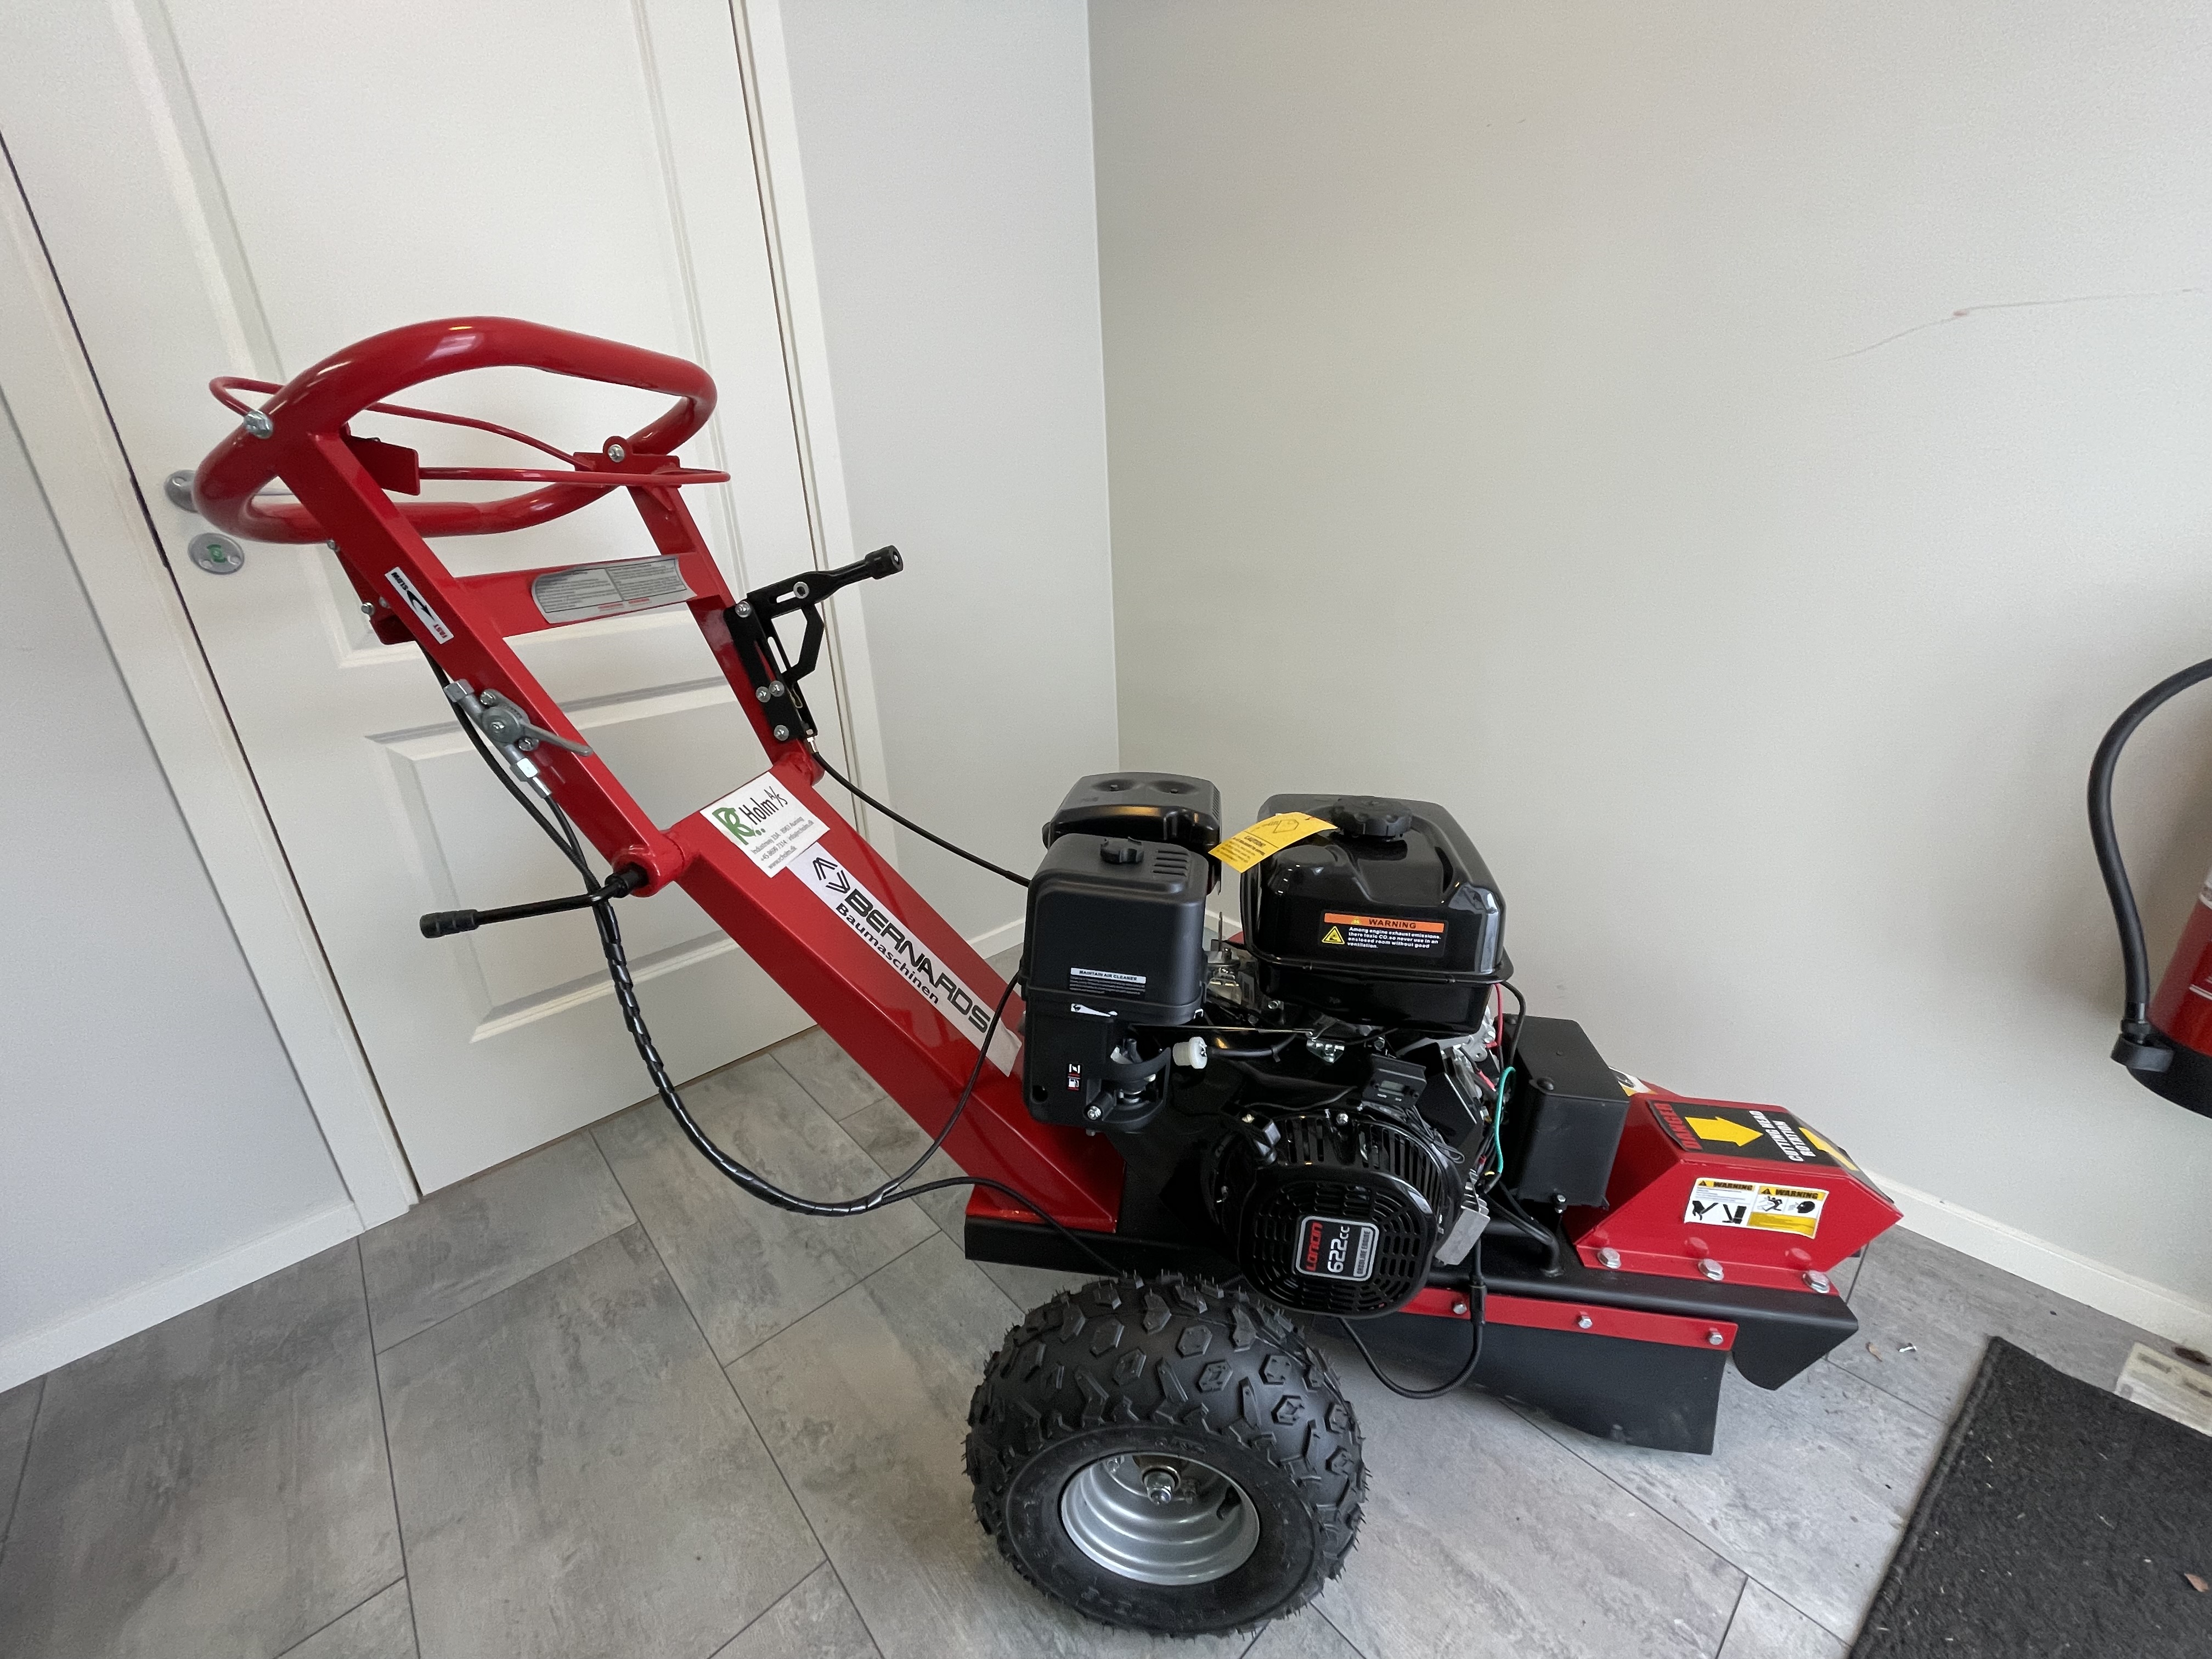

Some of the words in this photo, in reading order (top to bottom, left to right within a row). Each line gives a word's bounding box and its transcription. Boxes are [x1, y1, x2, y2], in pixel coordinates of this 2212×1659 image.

[391, 572, 408, 591] SLOW
[433, 624, 448, 639] FAST
[738, 797, 779, 825] Holm
[1369, 919, 1417, 929] WARNING
[836, 903, 939, 1004] Baumaschinen
[844, 888, 991, 1034] BERNARDS
[1654, 1103, 1703, 1150] DANGER
[1748, 1110, 1775, 1130] HEAD
[1765, 1128, 1804, 1163] CUTTING
[1771, 1120, 1816, 1158] ROTATION
[1713, 1181, 1753, 1191] WARNING
[1775, 1188, 1819, 1200] WARNING
[1327, 1226, 1350, 1273] 622cc
[1361, 1231, 1370, 1249] ENGINE
